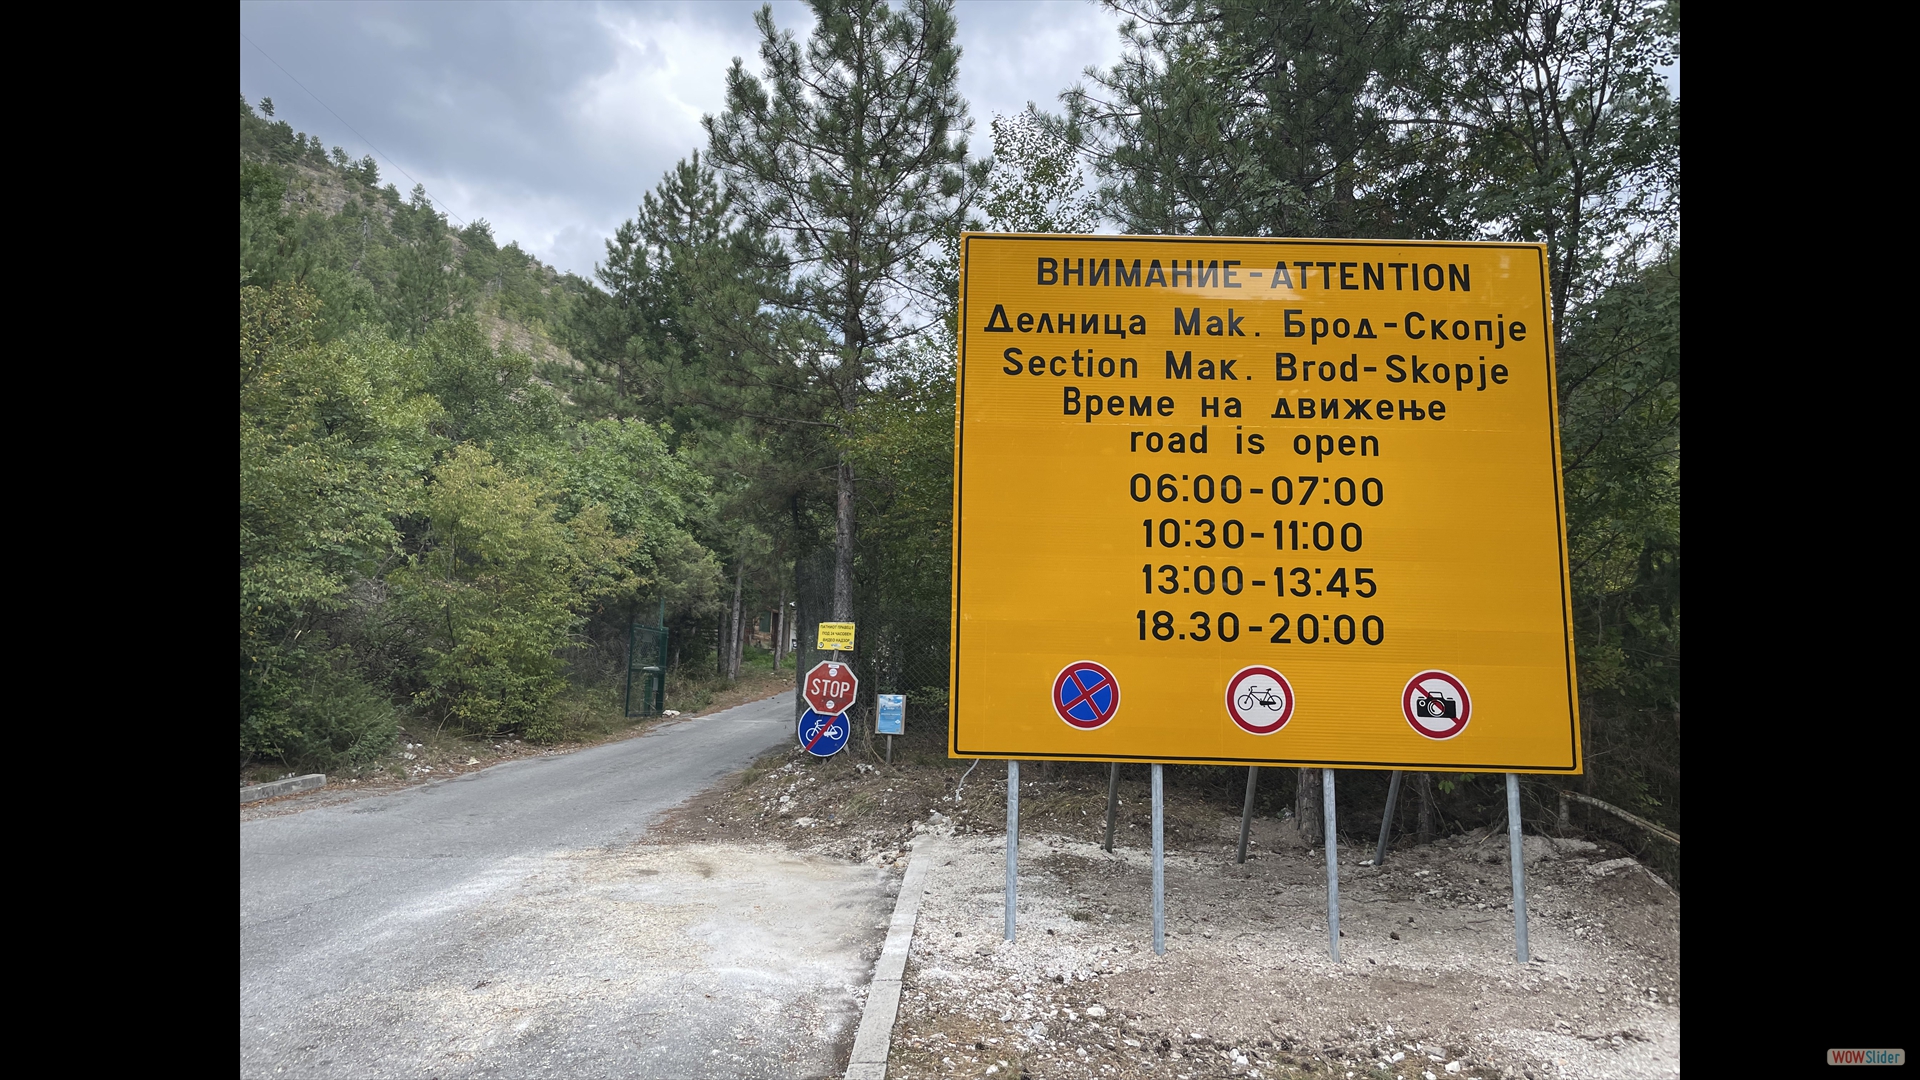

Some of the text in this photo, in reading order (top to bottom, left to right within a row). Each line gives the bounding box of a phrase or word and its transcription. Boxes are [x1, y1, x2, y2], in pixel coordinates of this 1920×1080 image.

[983, 303, 1147, 340] Делница
[1283, 309, 1528, 350] Брод-Скопје
[1002, 347, 1138, 379] Section
[1275, 352, 1510, 393] Brod-Skopje
[1063, 386, 1447, 424] Време на движење
[1130, 425, 1380, 464] road is open
[1130, 473, 1385, 508] 06:00-07:00
[1142, 518, 1363, 553] 10:30-11:00
[1142, 563, 1378, 599] 13:00-13:45
[1136, 609, 1386, 647] 18.30-20:00
[811, 678, 850, 699] STOP
